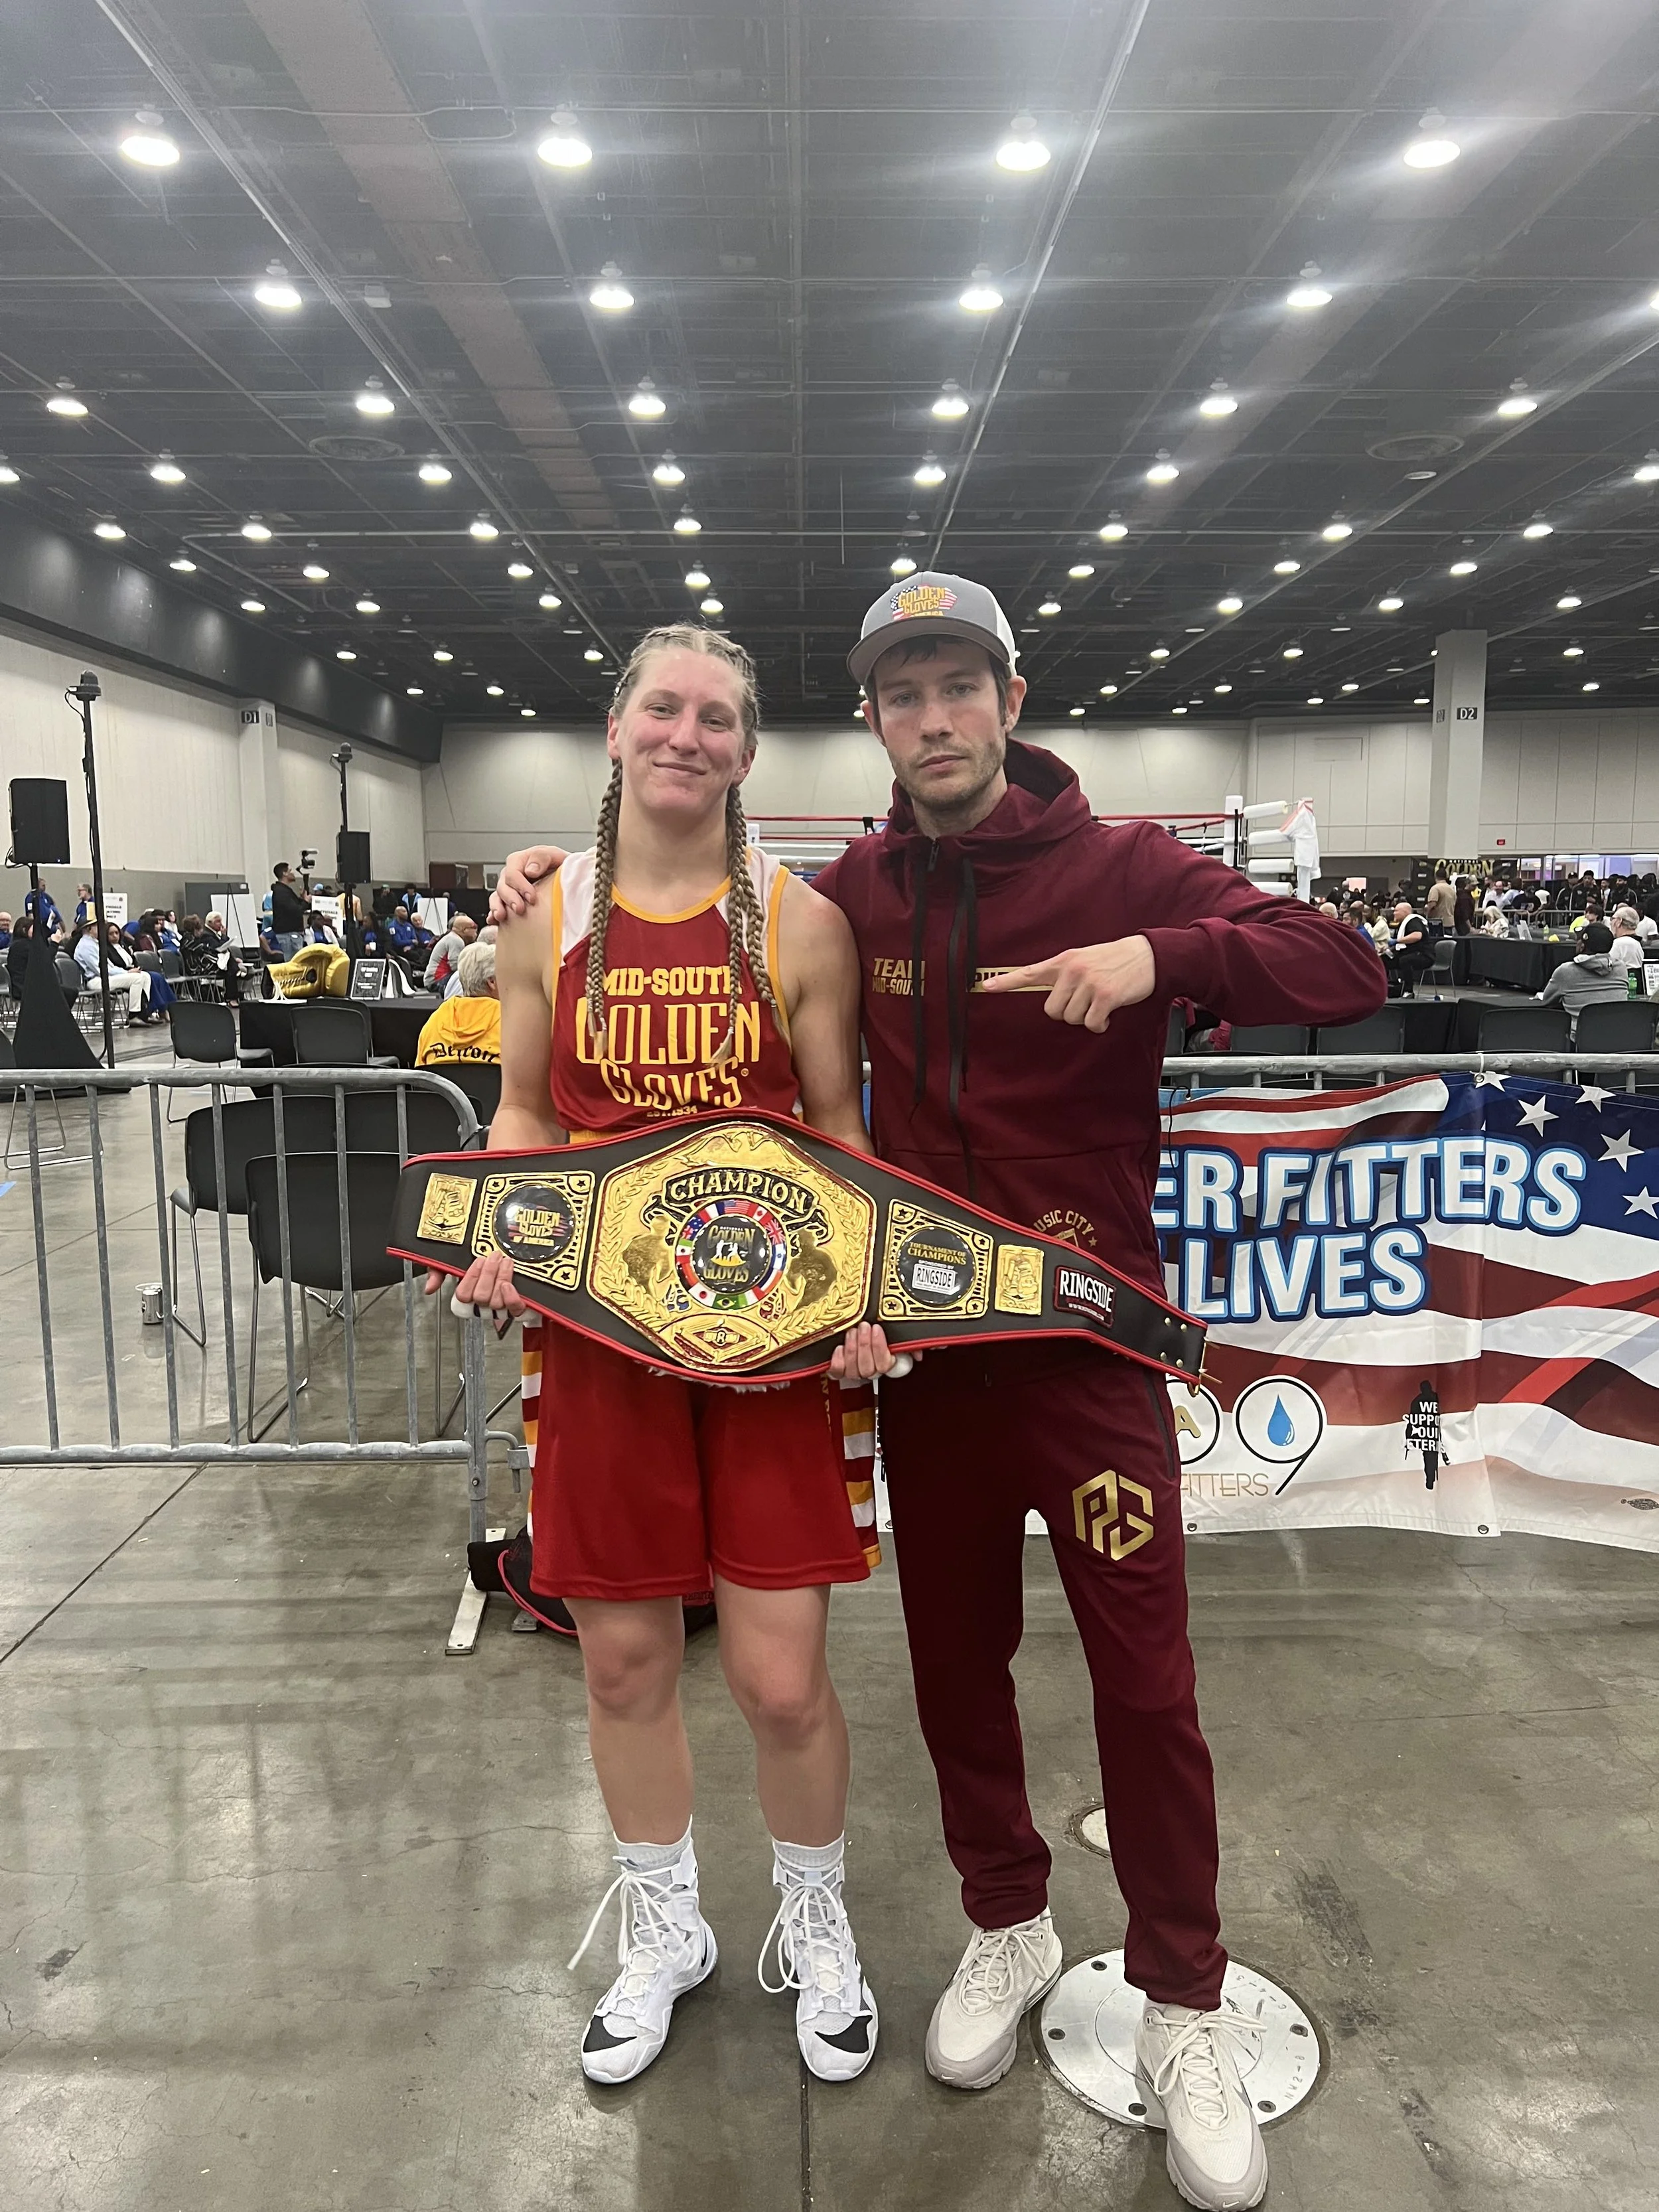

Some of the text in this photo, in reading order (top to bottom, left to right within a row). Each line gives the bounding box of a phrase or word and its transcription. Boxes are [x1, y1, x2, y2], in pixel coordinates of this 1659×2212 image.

[898, 587, 946, 608] GOLDEN
[904, 597, 940, 614] GLOVES
[1460, 707, 1475, 719] D2
[575, 997, 761, 1065] GOLDEN
[670, 1171, 808, 1215] CHAMPION
[1260, 1137, 1587, 1231] FITTERS
[1033, 1209, 1062, 1232] USIC
[1065, 1210, 1094, 1235] CITY
[707, 1225, 756, 1254] GOLDEN
[909, 1242, 956, 1255] TOURNAMENT
[907, 1248, 967, 1265] CHAMPIONS
[704, 1263, 749, 1283] GLOVES
[916, 1267, 952, 1288] RINGSIDE
[1185, 1227, 1425, 1318] LIVES
[1059, 1270, 1114, 1313] RINGSIDE
[1419, 1401, 1438, 1413] WE
